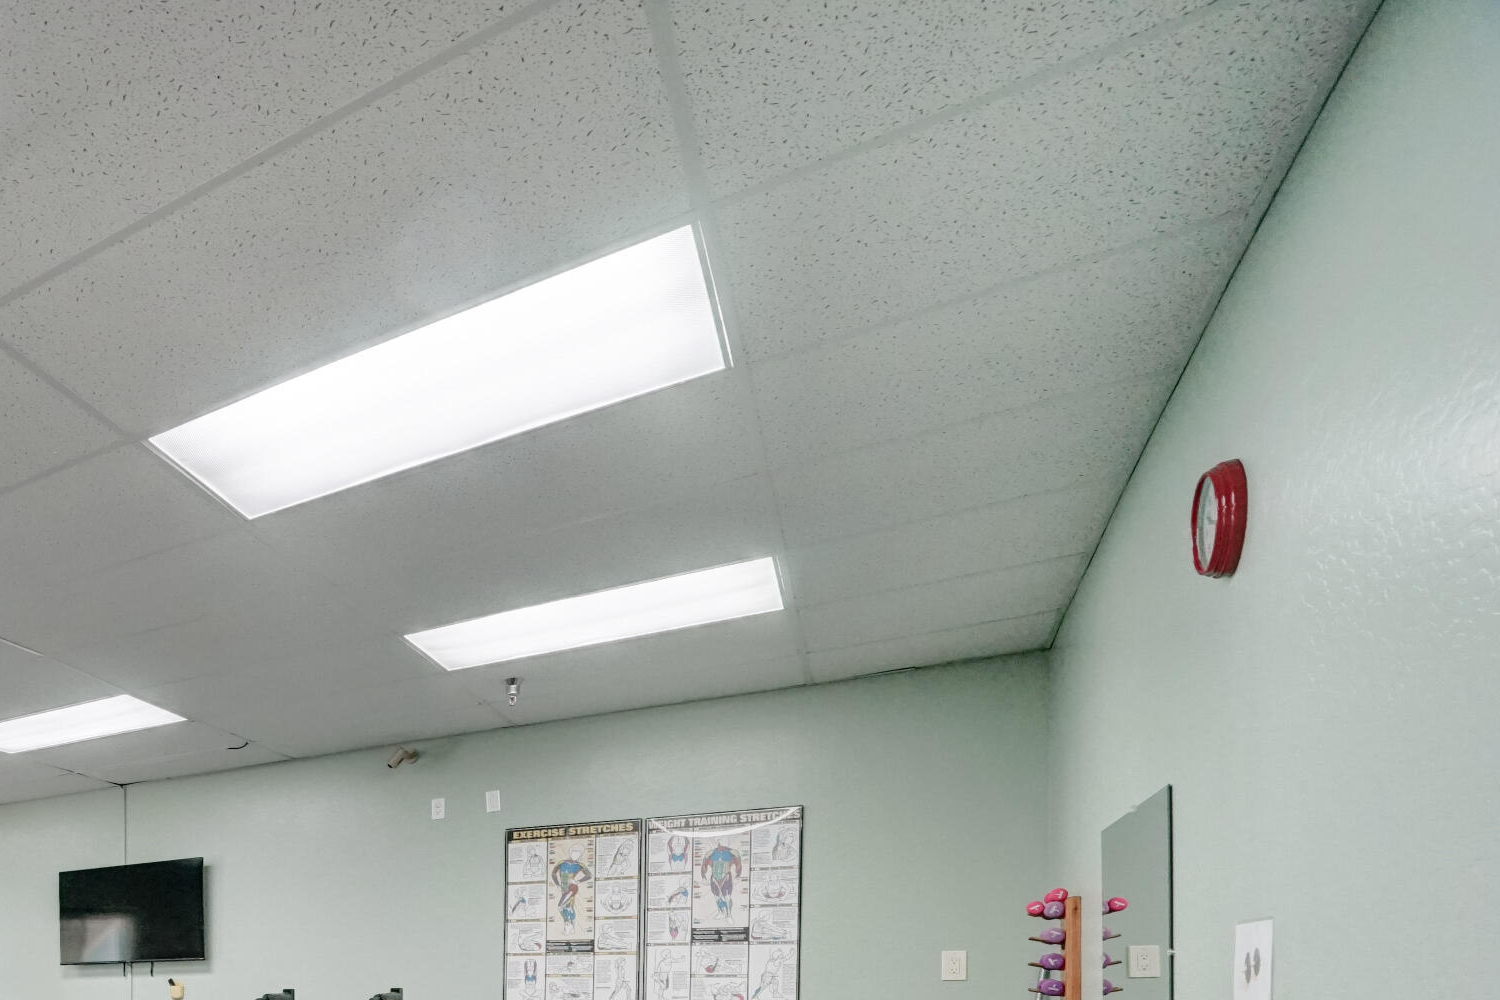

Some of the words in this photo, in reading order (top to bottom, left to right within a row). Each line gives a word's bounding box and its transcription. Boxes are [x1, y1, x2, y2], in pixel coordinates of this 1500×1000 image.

[689, 814, 738, 827] TRAINING
[512, 827, 565, 840] EXERCISE
[568, 822, 634, 836] STRETCHES
